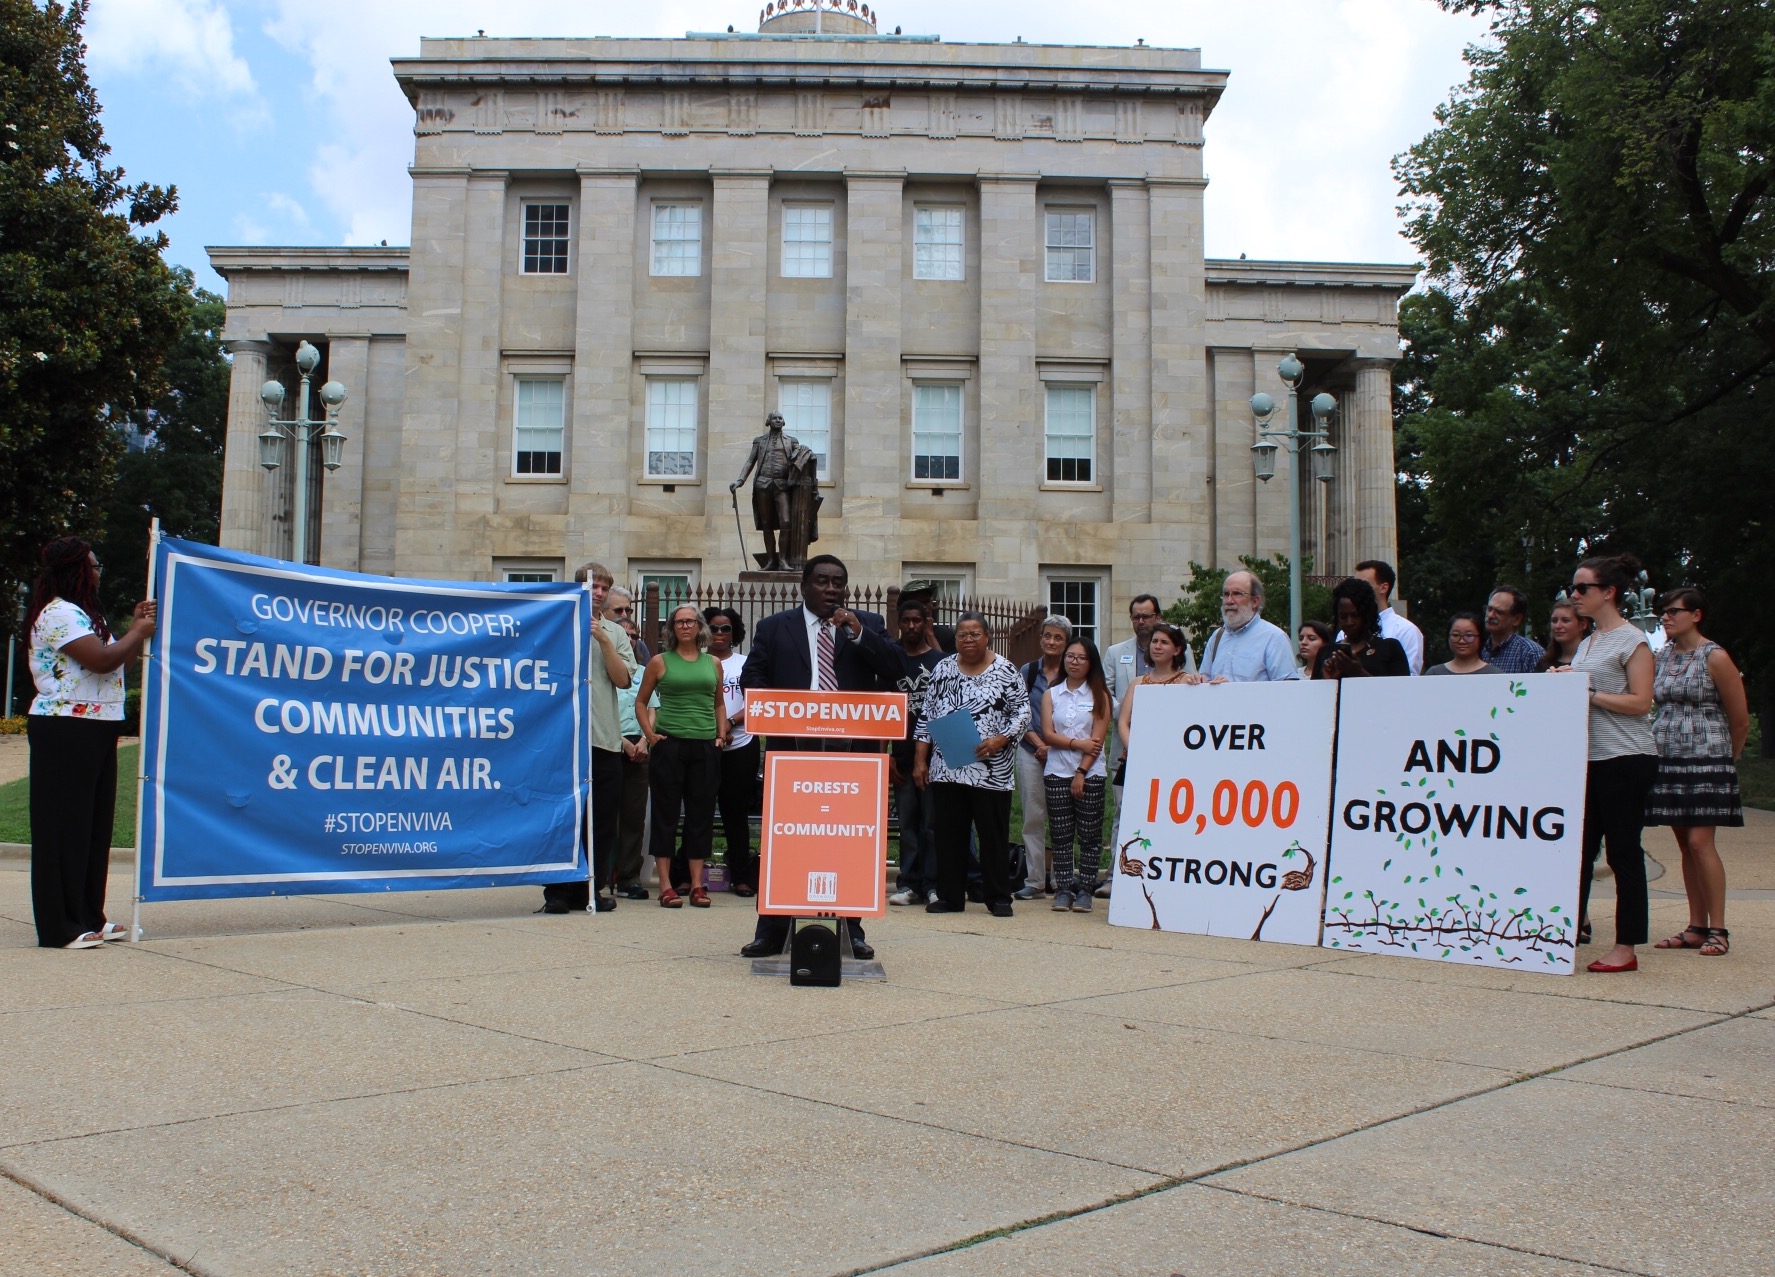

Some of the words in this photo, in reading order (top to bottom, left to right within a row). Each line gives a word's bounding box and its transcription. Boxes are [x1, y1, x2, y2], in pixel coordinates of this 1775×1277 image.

[252, 594, 404, 632] GOVERNOR
[410, 610, 521, 638] COOPER:
[194, 638, 333, 681] STAND
[341, 649, 415, 686] FOR
[420, 654, 558, 696] JUSTICE,
[254, 698, 515, 739] COMMUNITIES
[749, 700, 902, 721] #STOPENVIVA
[1183, 723, 1266, 751] OVER
[267, 754, 298, 790] &
[307, 754, 429, 790] CLEAN
[436, 757, 501, 790] AIR.
[1403, 739, 1501, 774] AND
[793, 781, 860, 794] FORESTS
[324, 811, 453, 833] #STOPENVIVA
[1147, 778, 1300, 835] 10,000
[1343, 799, 1565, 841] GROWING
[773, 822, 876, 838] COMMUNITY
[341, 842, 438, 855] STOPENVIVA.ORG
[1147, 856, 1278, 889] STRONG
